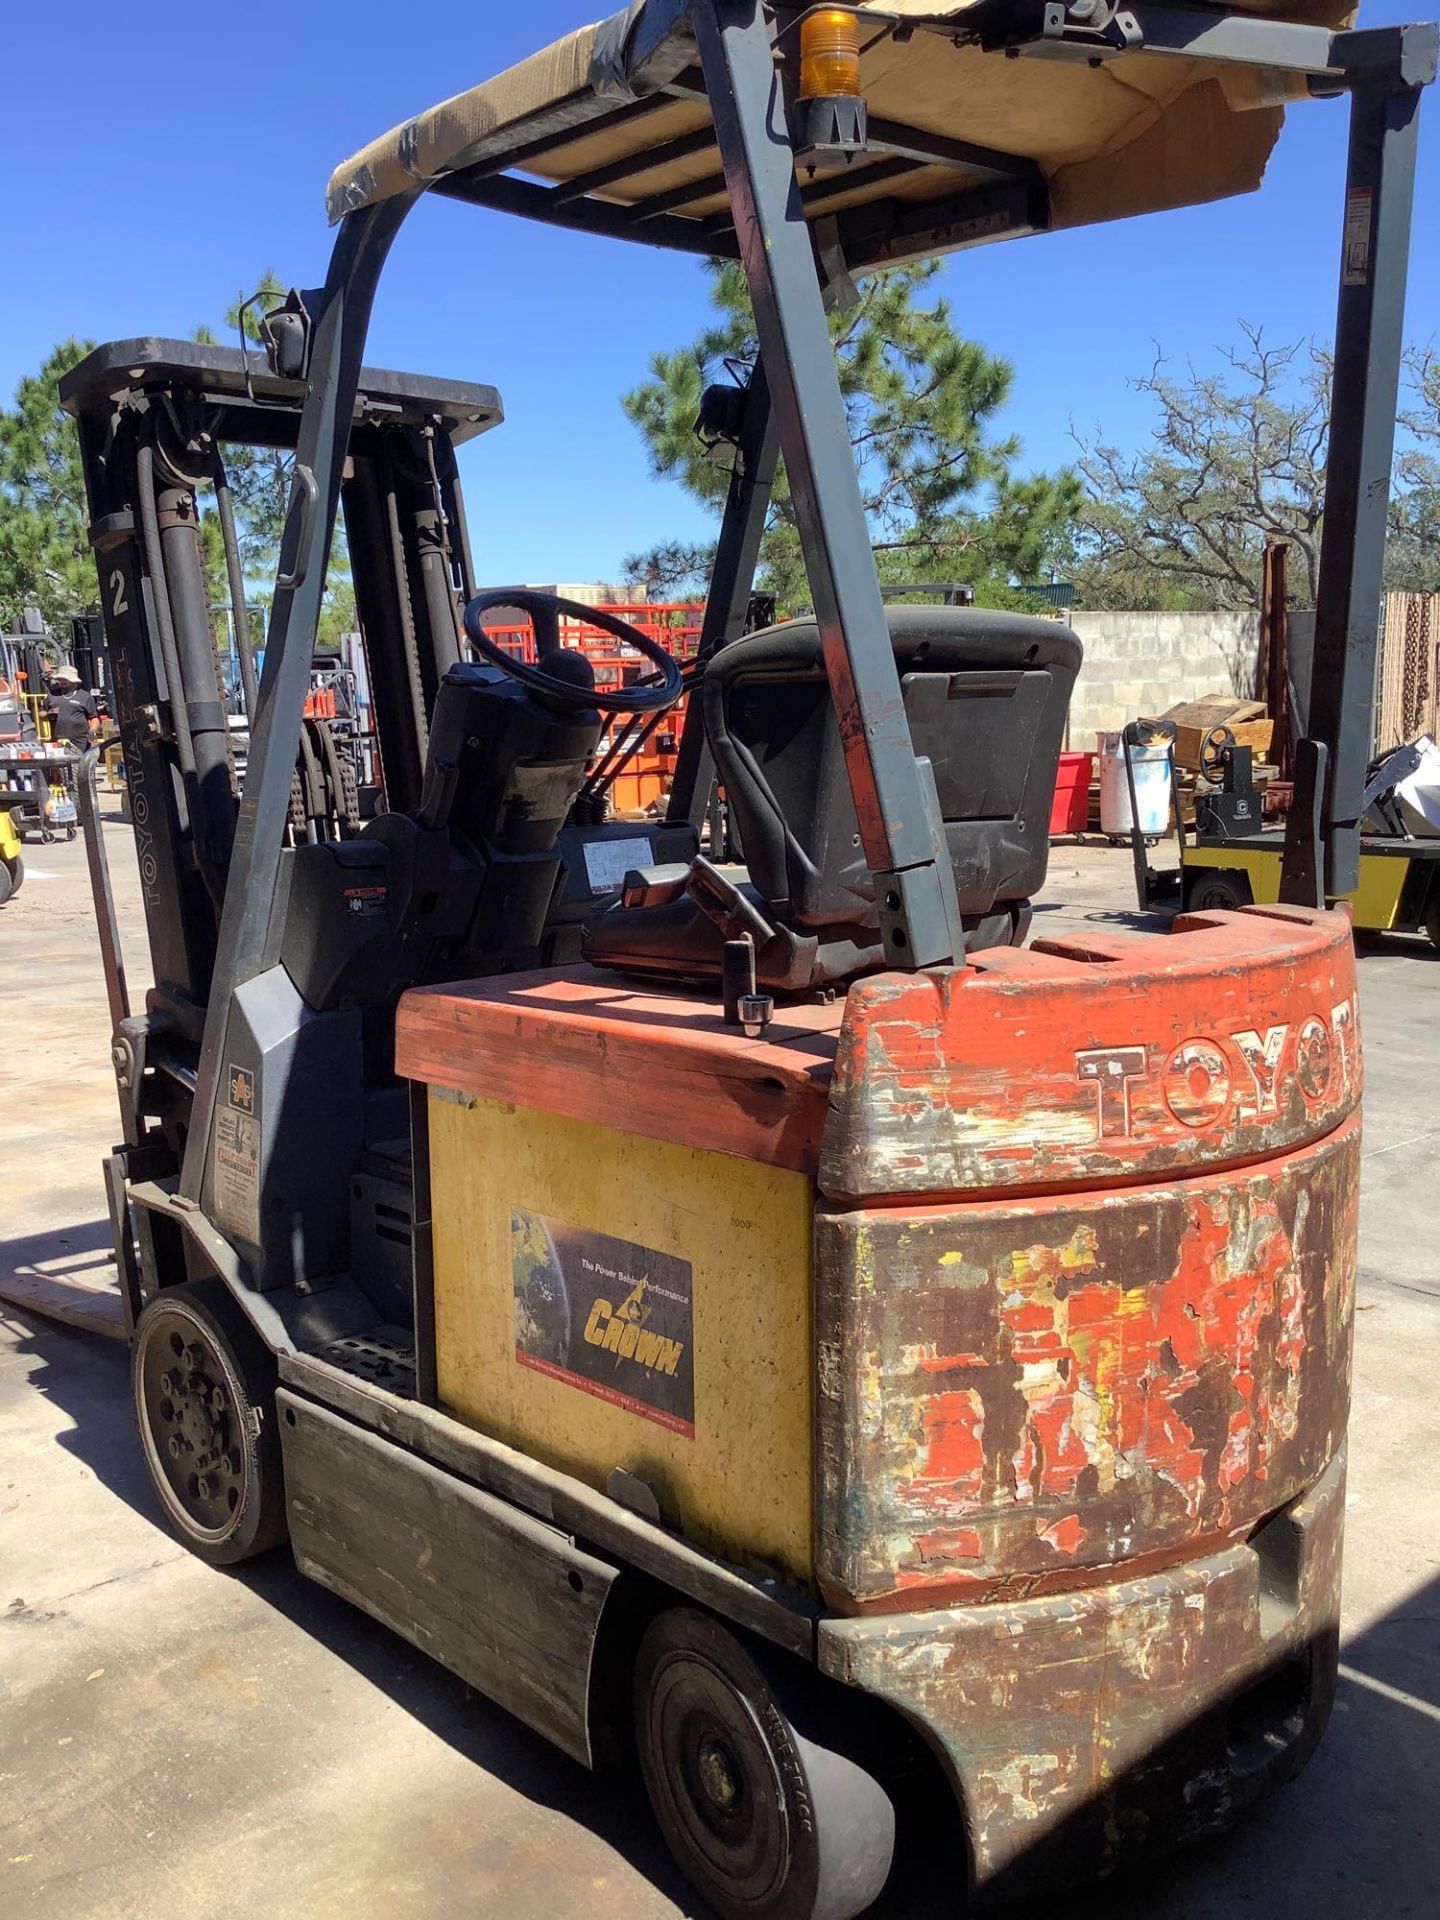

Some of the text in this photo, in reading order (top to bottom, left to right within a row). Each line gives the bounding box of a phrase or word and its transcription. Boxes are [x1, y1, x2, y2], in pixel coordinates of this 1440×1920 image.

[108, 569, 130, 616] 2
[581, 1258, 594, 1271] The
[595, 1263, 617, 1279] Power
[583, 1297, 684, 1376] CROWN
